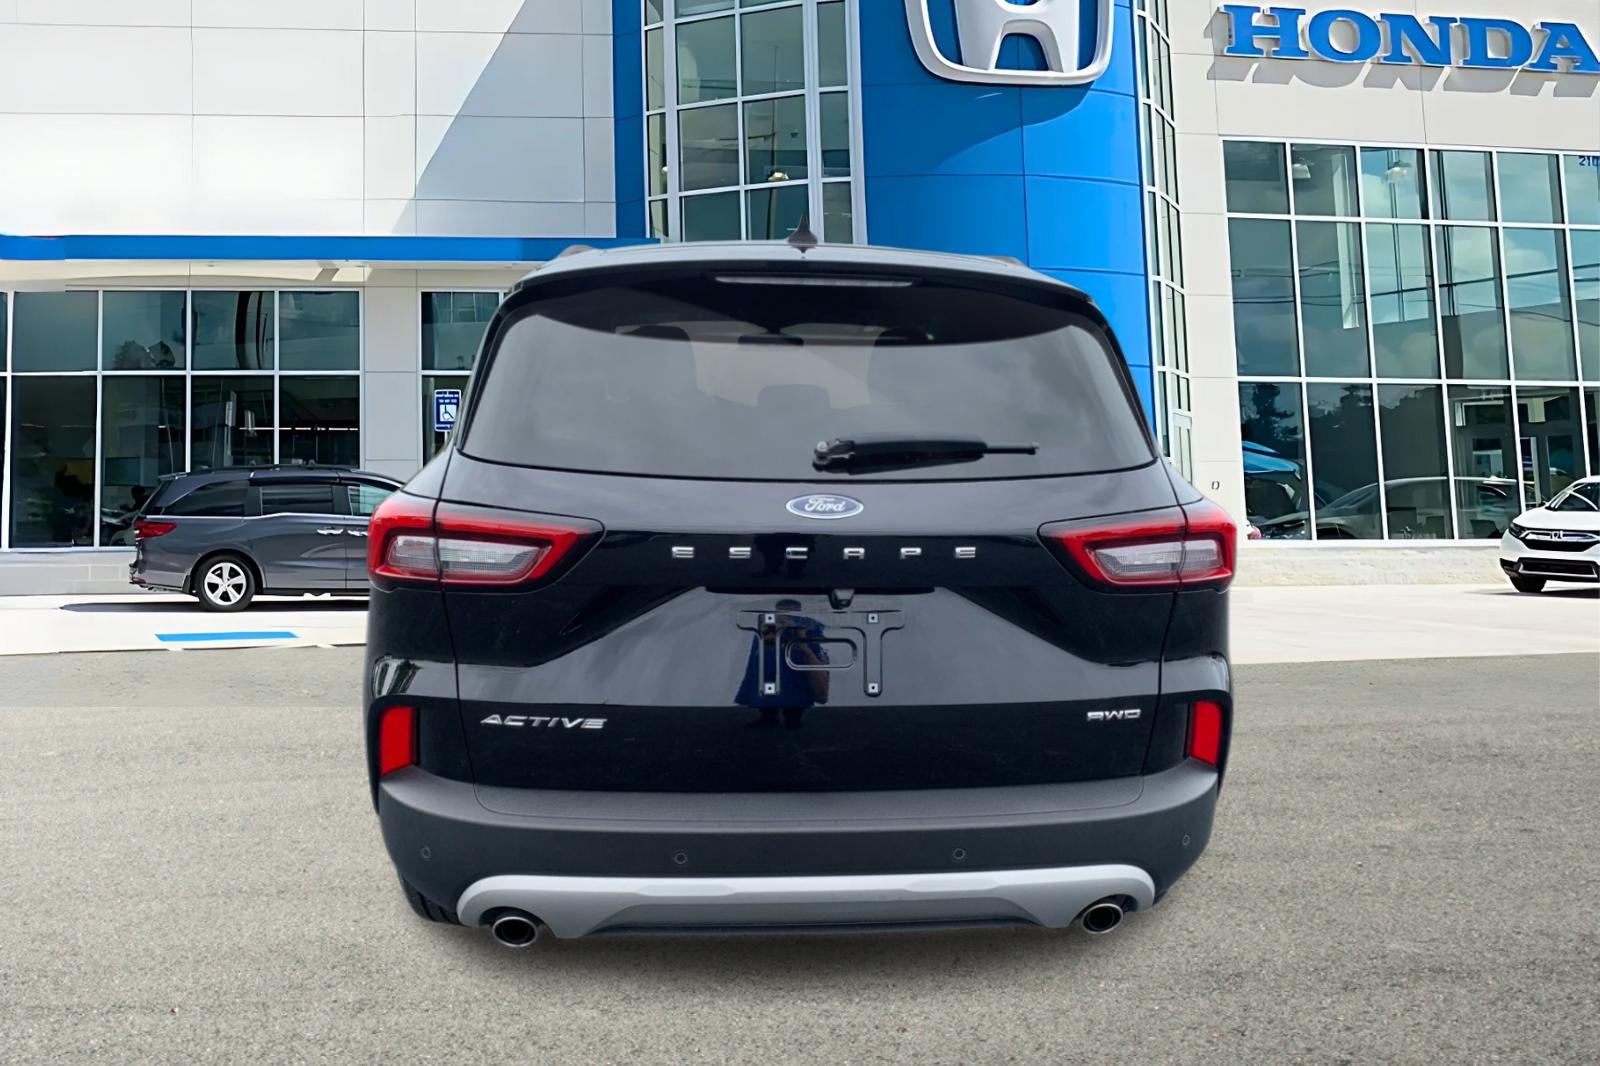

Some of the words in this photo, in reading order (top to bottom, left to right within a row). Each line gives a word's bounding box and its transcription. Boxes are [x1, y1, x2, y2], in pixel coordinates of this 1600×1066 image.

[1219, 4, 1600, 73] HONDA
[804, 497, 846, 512] Ford
[671, 546, 977, 560] ESCAPE
[480, 714, 608, 729] ACTIVE
[1086, 708, 1141, 721] AWD
